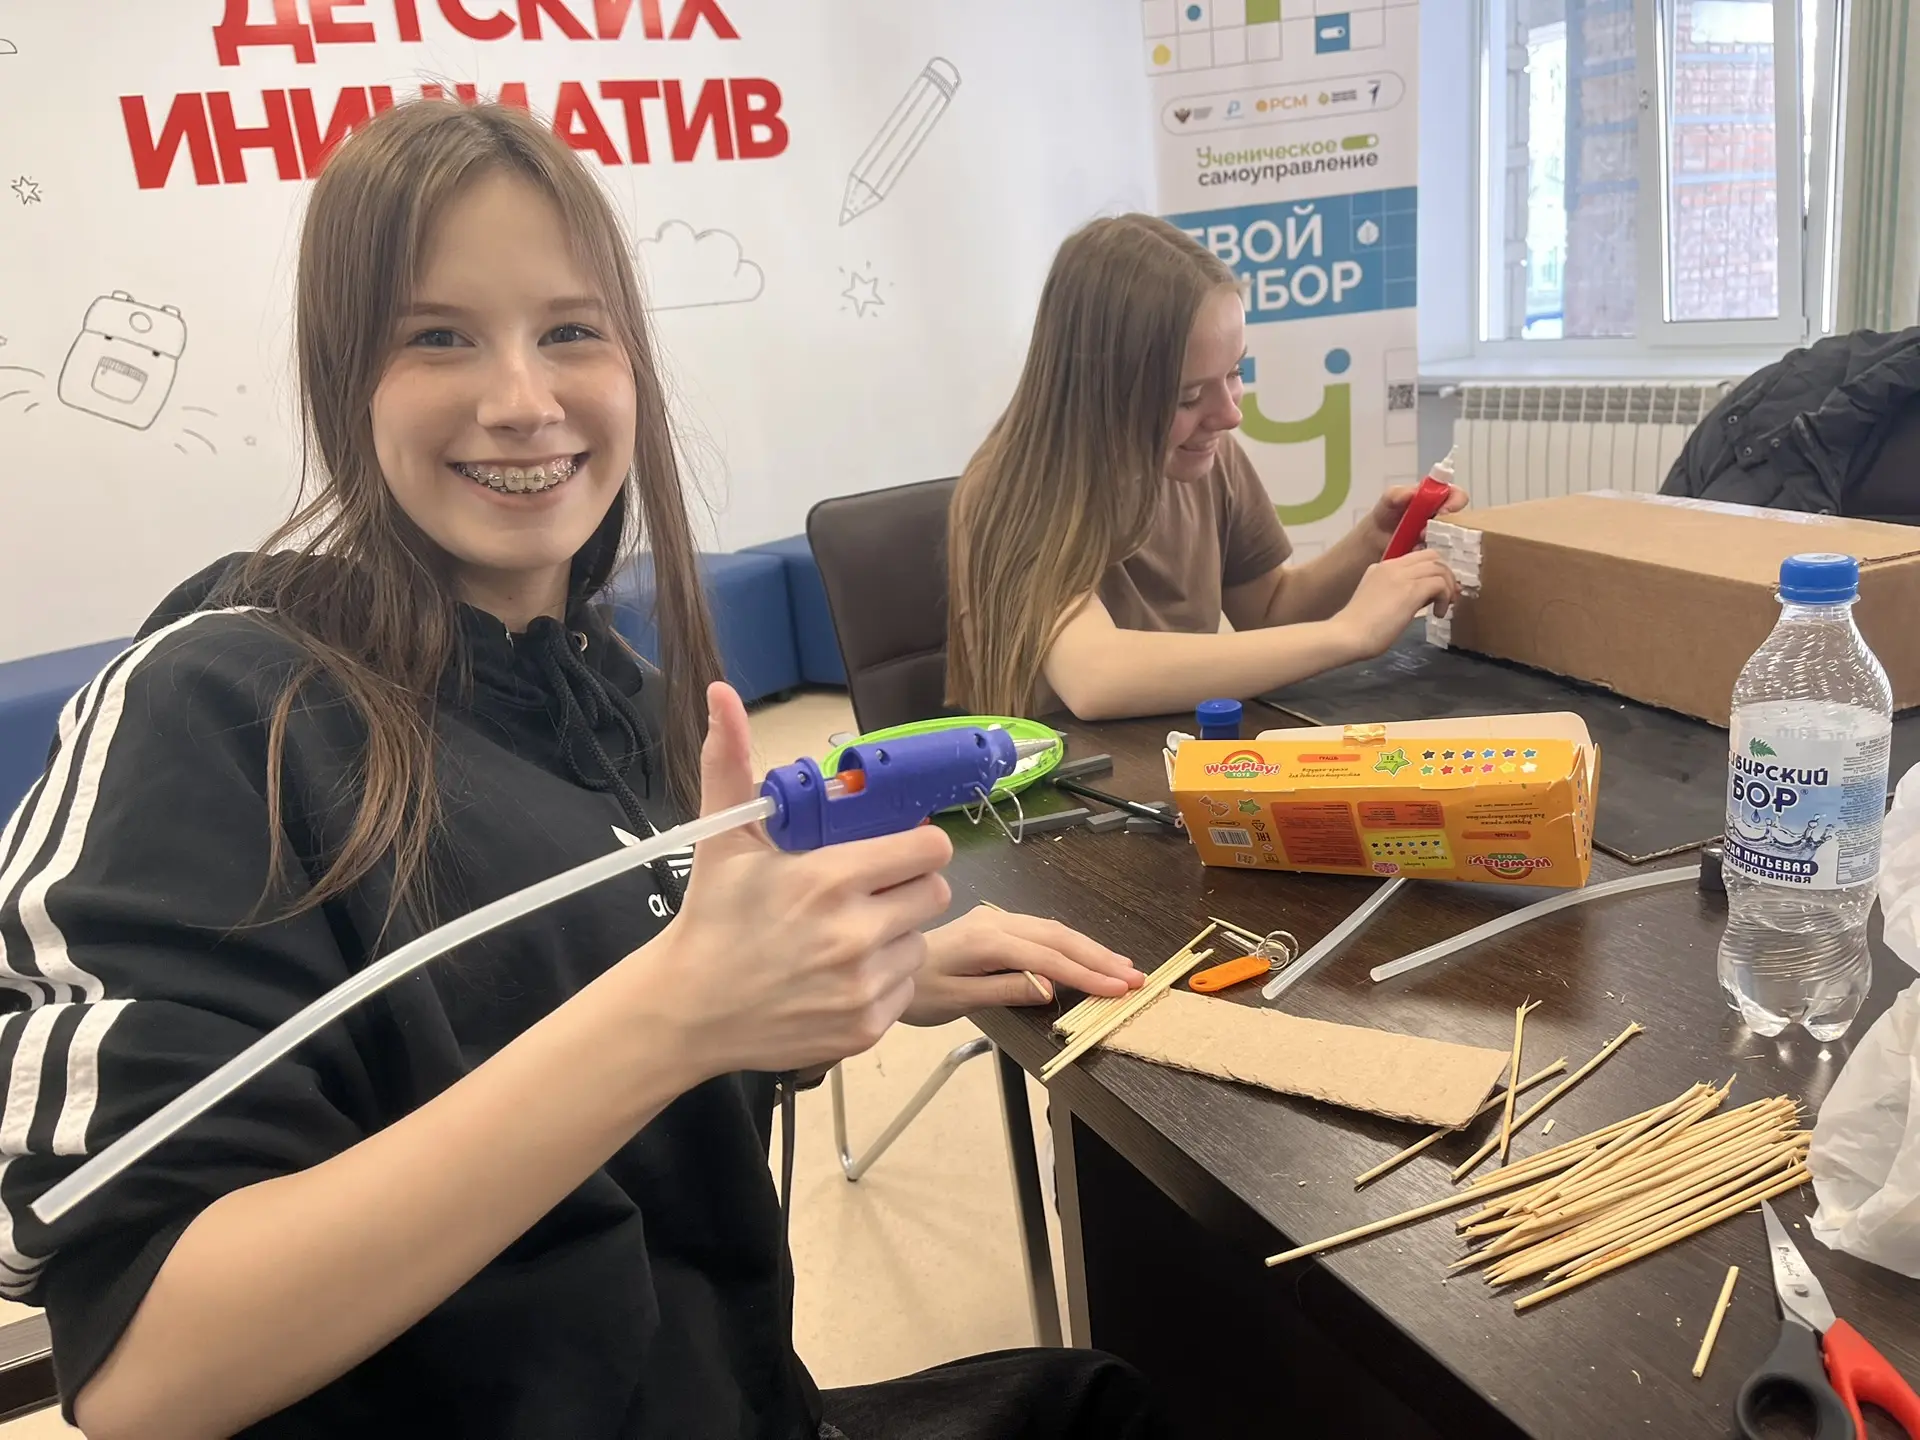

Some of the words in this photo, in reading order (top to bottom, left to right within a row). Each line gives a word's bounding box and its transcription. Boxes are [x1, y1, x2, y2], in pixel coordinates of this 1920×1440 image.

[119, 77, 790, 190] ИНИАТИВ
[1197, 139, 1337, 168] Ученическое
[1198, 152, 1378, 186] самоуправление
[1205, 762, 1280, 775] WowPlay!
[1733, 773, 1797, 813] БОР
[1467, 856, 1552, 869] WowPlay!
[1744, 850, 1811, 874] ПИТЬЕВАЯ
